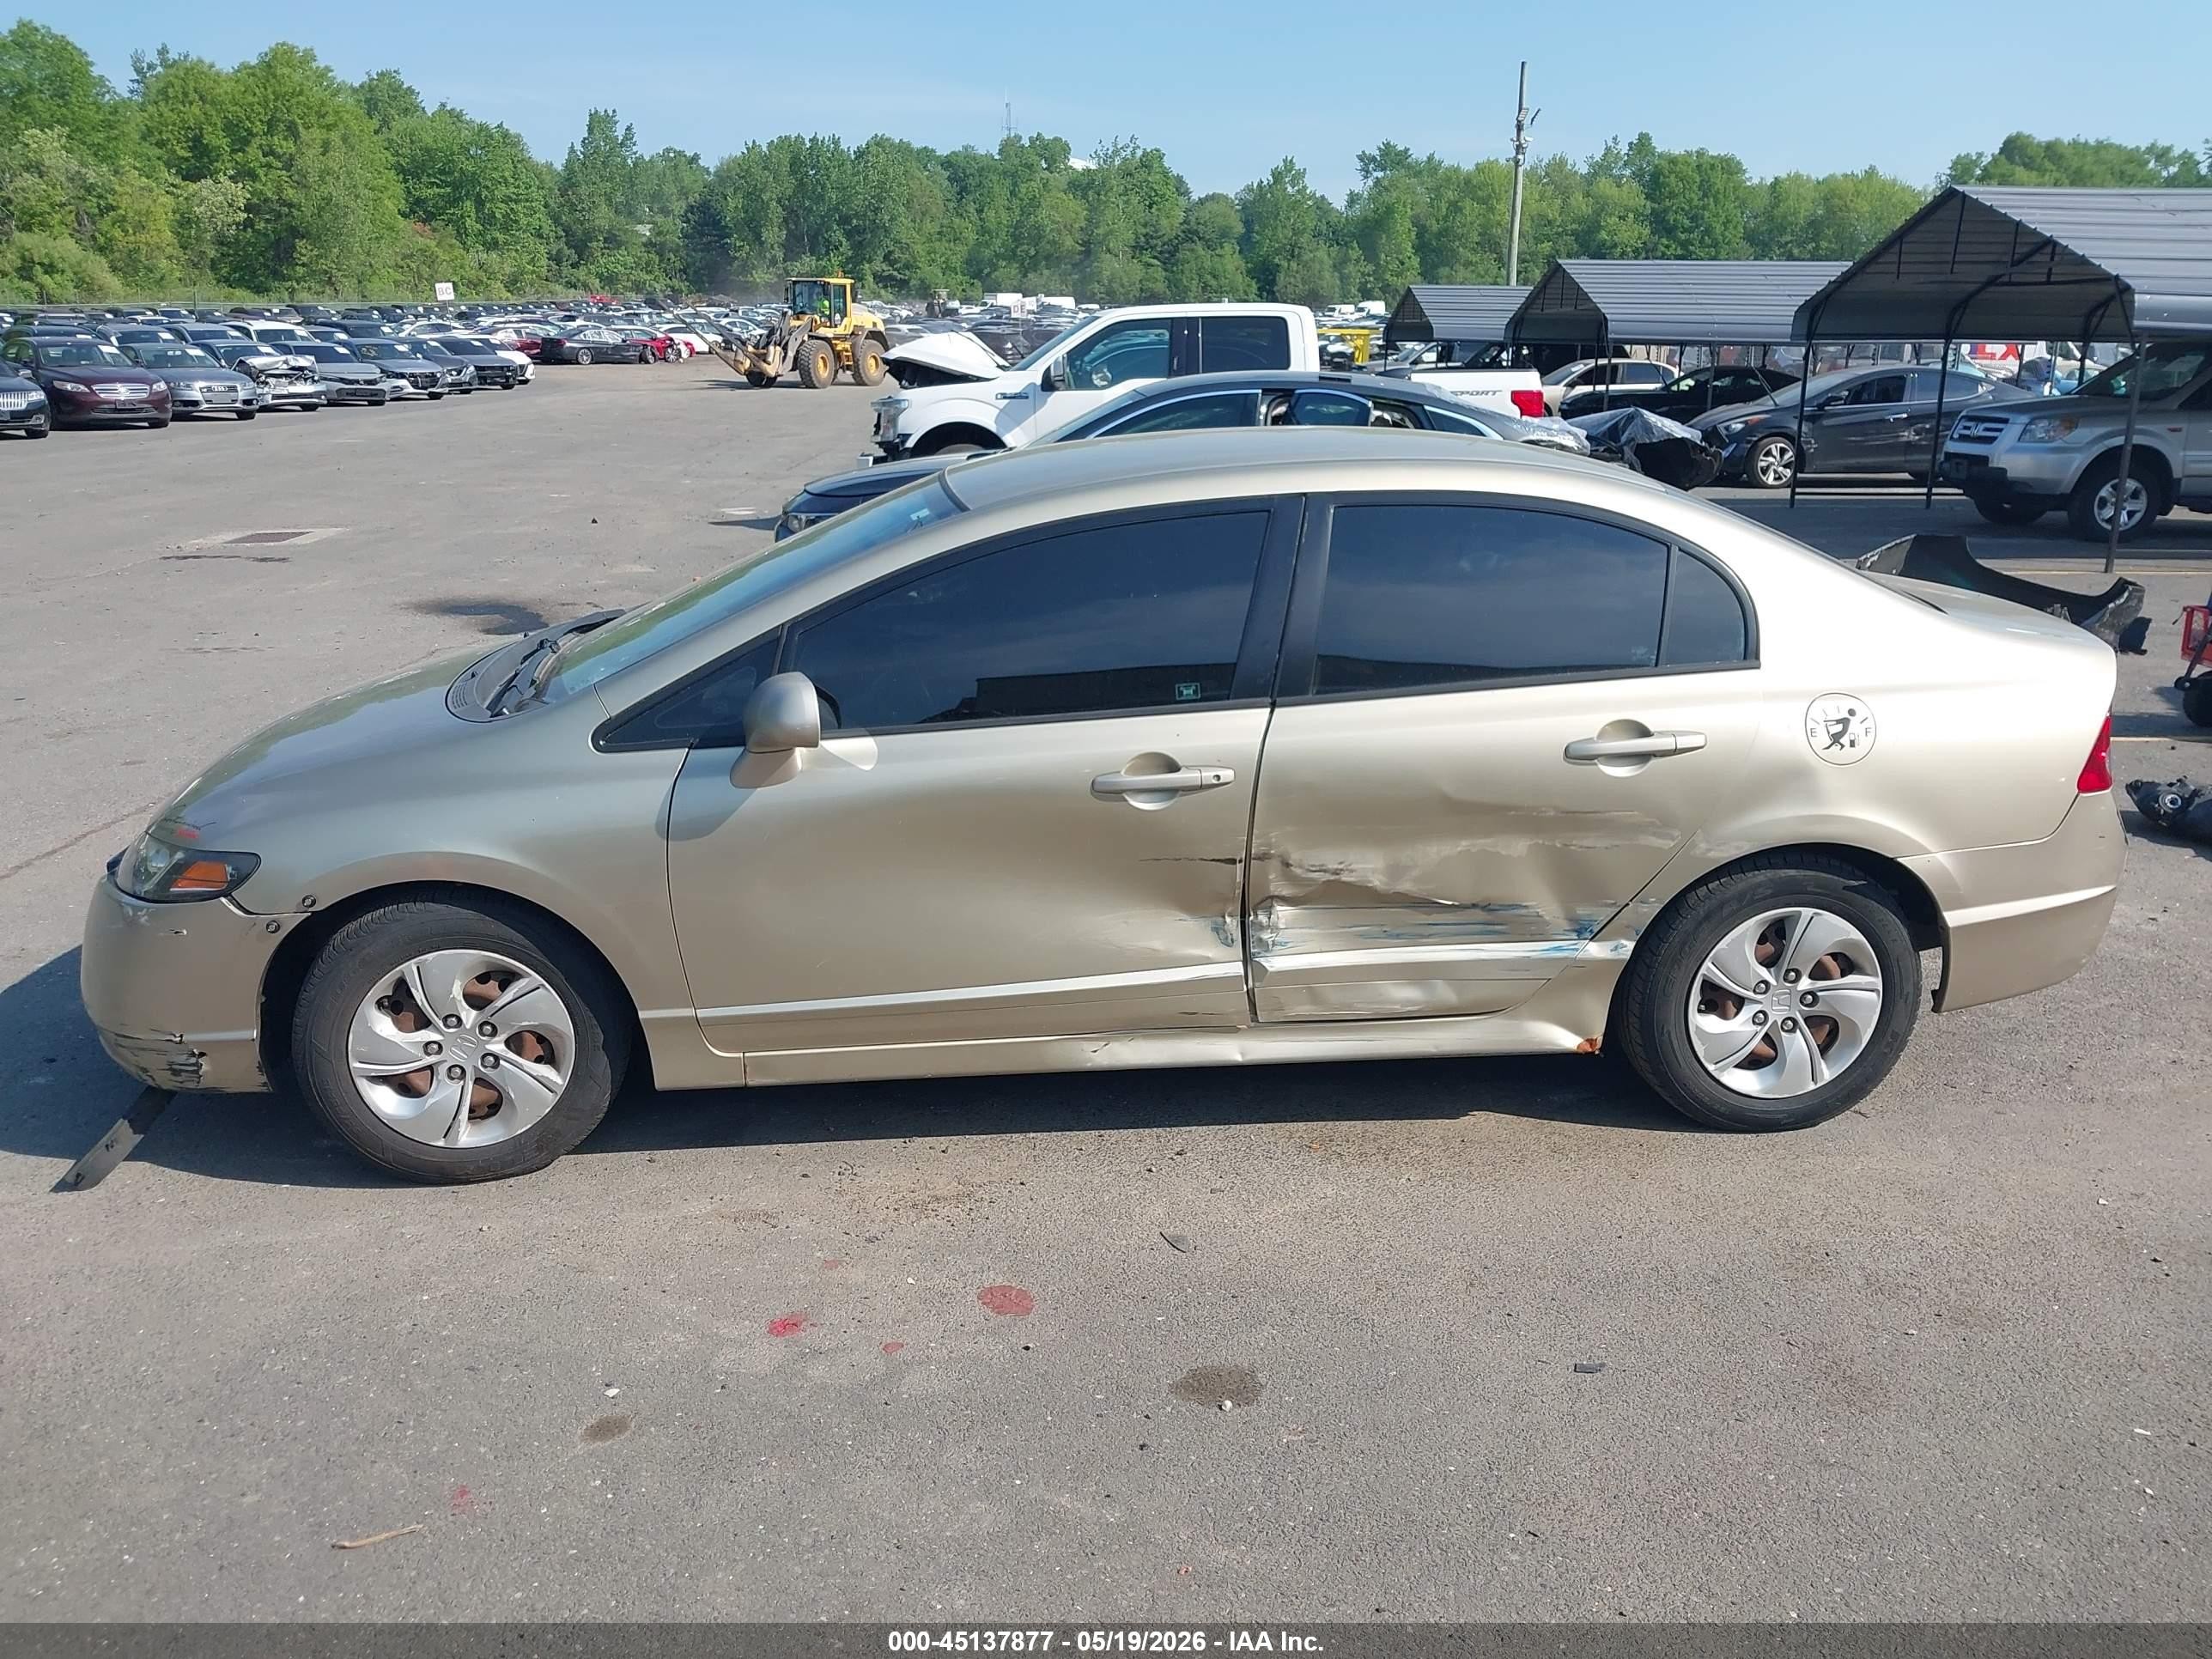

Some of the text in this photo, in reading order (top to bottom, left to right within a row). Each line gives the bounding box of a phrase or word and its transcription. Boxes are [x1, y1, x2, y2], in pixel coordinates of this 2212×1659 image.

[437, 287, 452, 295] BC
[1012, 304, 1025, 313] DE
[1809, 726, 1872, 738] E F
